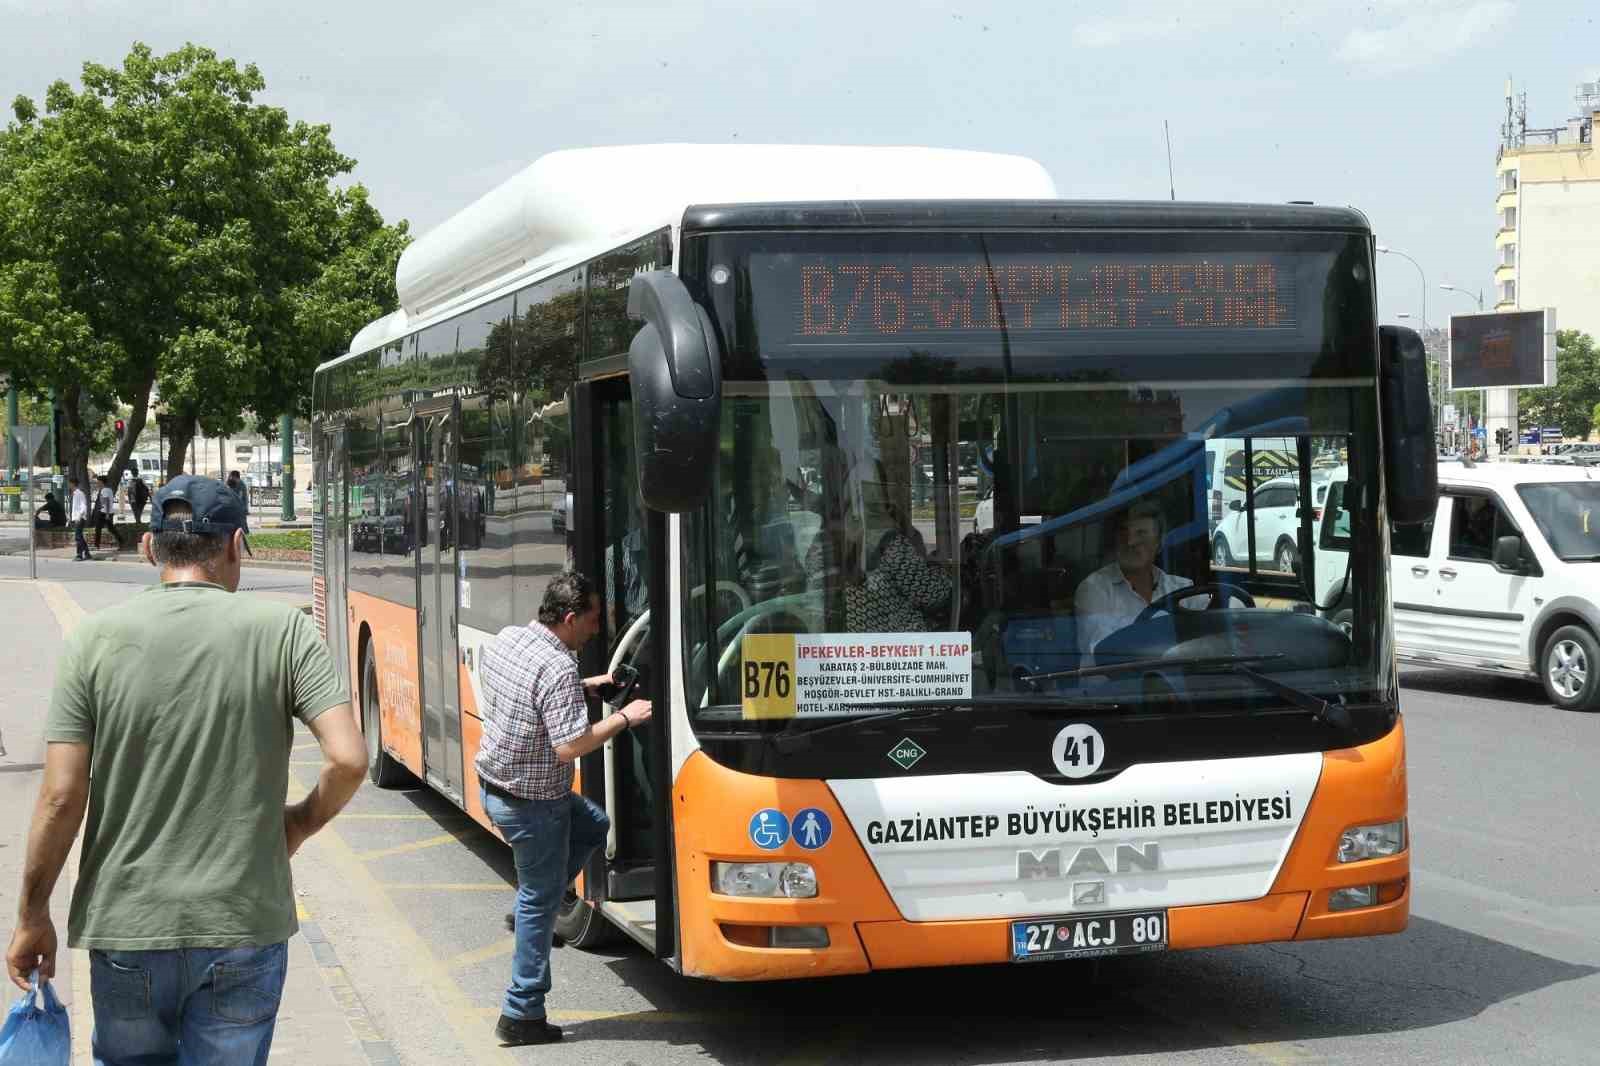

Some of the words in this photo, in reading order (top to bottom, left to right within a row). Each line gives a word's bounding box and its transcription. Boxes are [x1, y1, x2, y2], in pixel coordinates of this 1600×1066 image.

[801, 265, 905, 336] B76
[928, 644, 969, 657] 1.ETAP
[744, 660, 790, 698] B76
[896, 748, 918, 759] CNG
[1063, 735, 1095, 767] 41
[866, 811, 1000, 845] GAZİANTEP
[1007, 799, 1156, 838] BÜYÜKŞEHİR
[1163, 790, 1292, 826] BELEDİYESİ
[1016, 842, 1159, 879] MAN
[1026, 924, 1055, 951] 27
[1073, 920, 1116, 947] ACJ
[1132, 916, 1161, 943] 80
